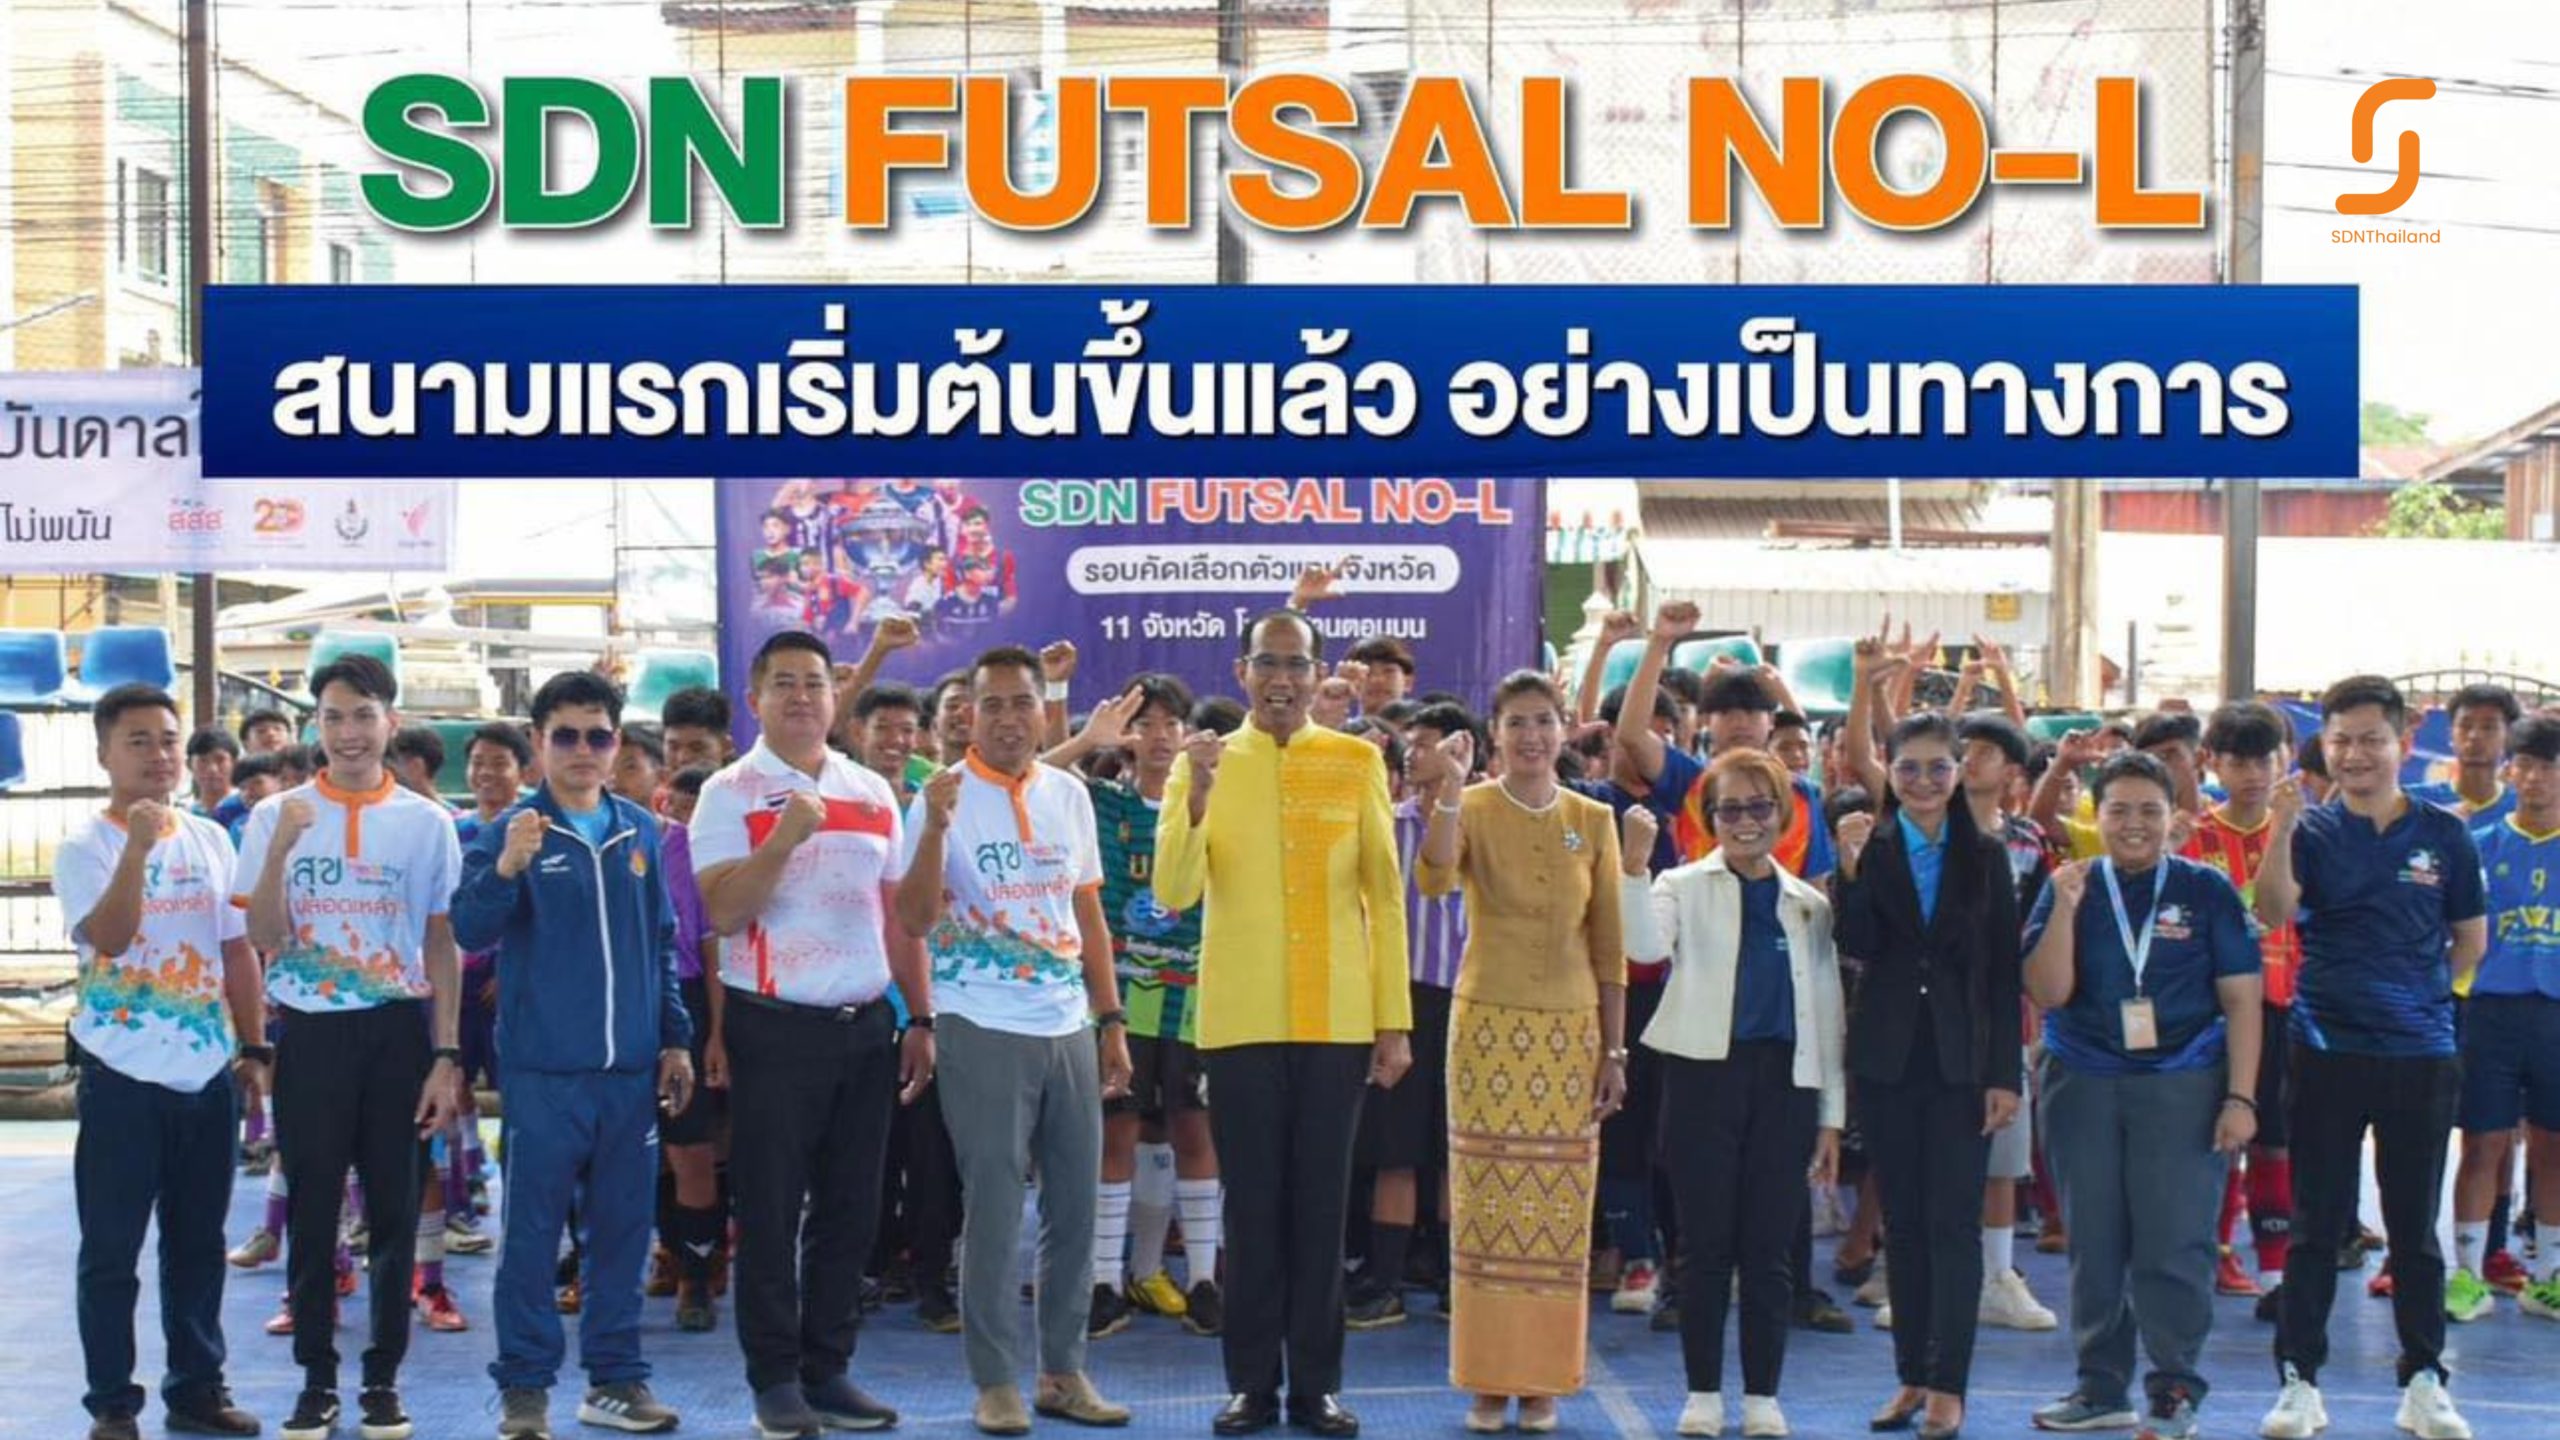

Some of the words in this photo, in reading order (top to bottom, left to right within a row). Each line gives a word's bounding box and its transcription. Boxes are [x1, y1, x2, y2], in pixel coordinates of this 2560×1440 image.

[0, 390, 201, 458] บันดาล
[0, 503, 111, 542] ไม่พนัน
[1020, 479, 1137, 527] SDN
[1147, 478, 1362, 524] FUTSAL
[1371, 478, 1513, 524] NO-L
[1084, 553, 1436, 583] รอบคัดเลือกตัวแนจังหวัด
[1101, 615, 1130, 640] 11
[1141, 610, 1226, 640] จังหวัด
[293, 856, 343, 897] สุข
[975, 842, 1020, 883] สุข
